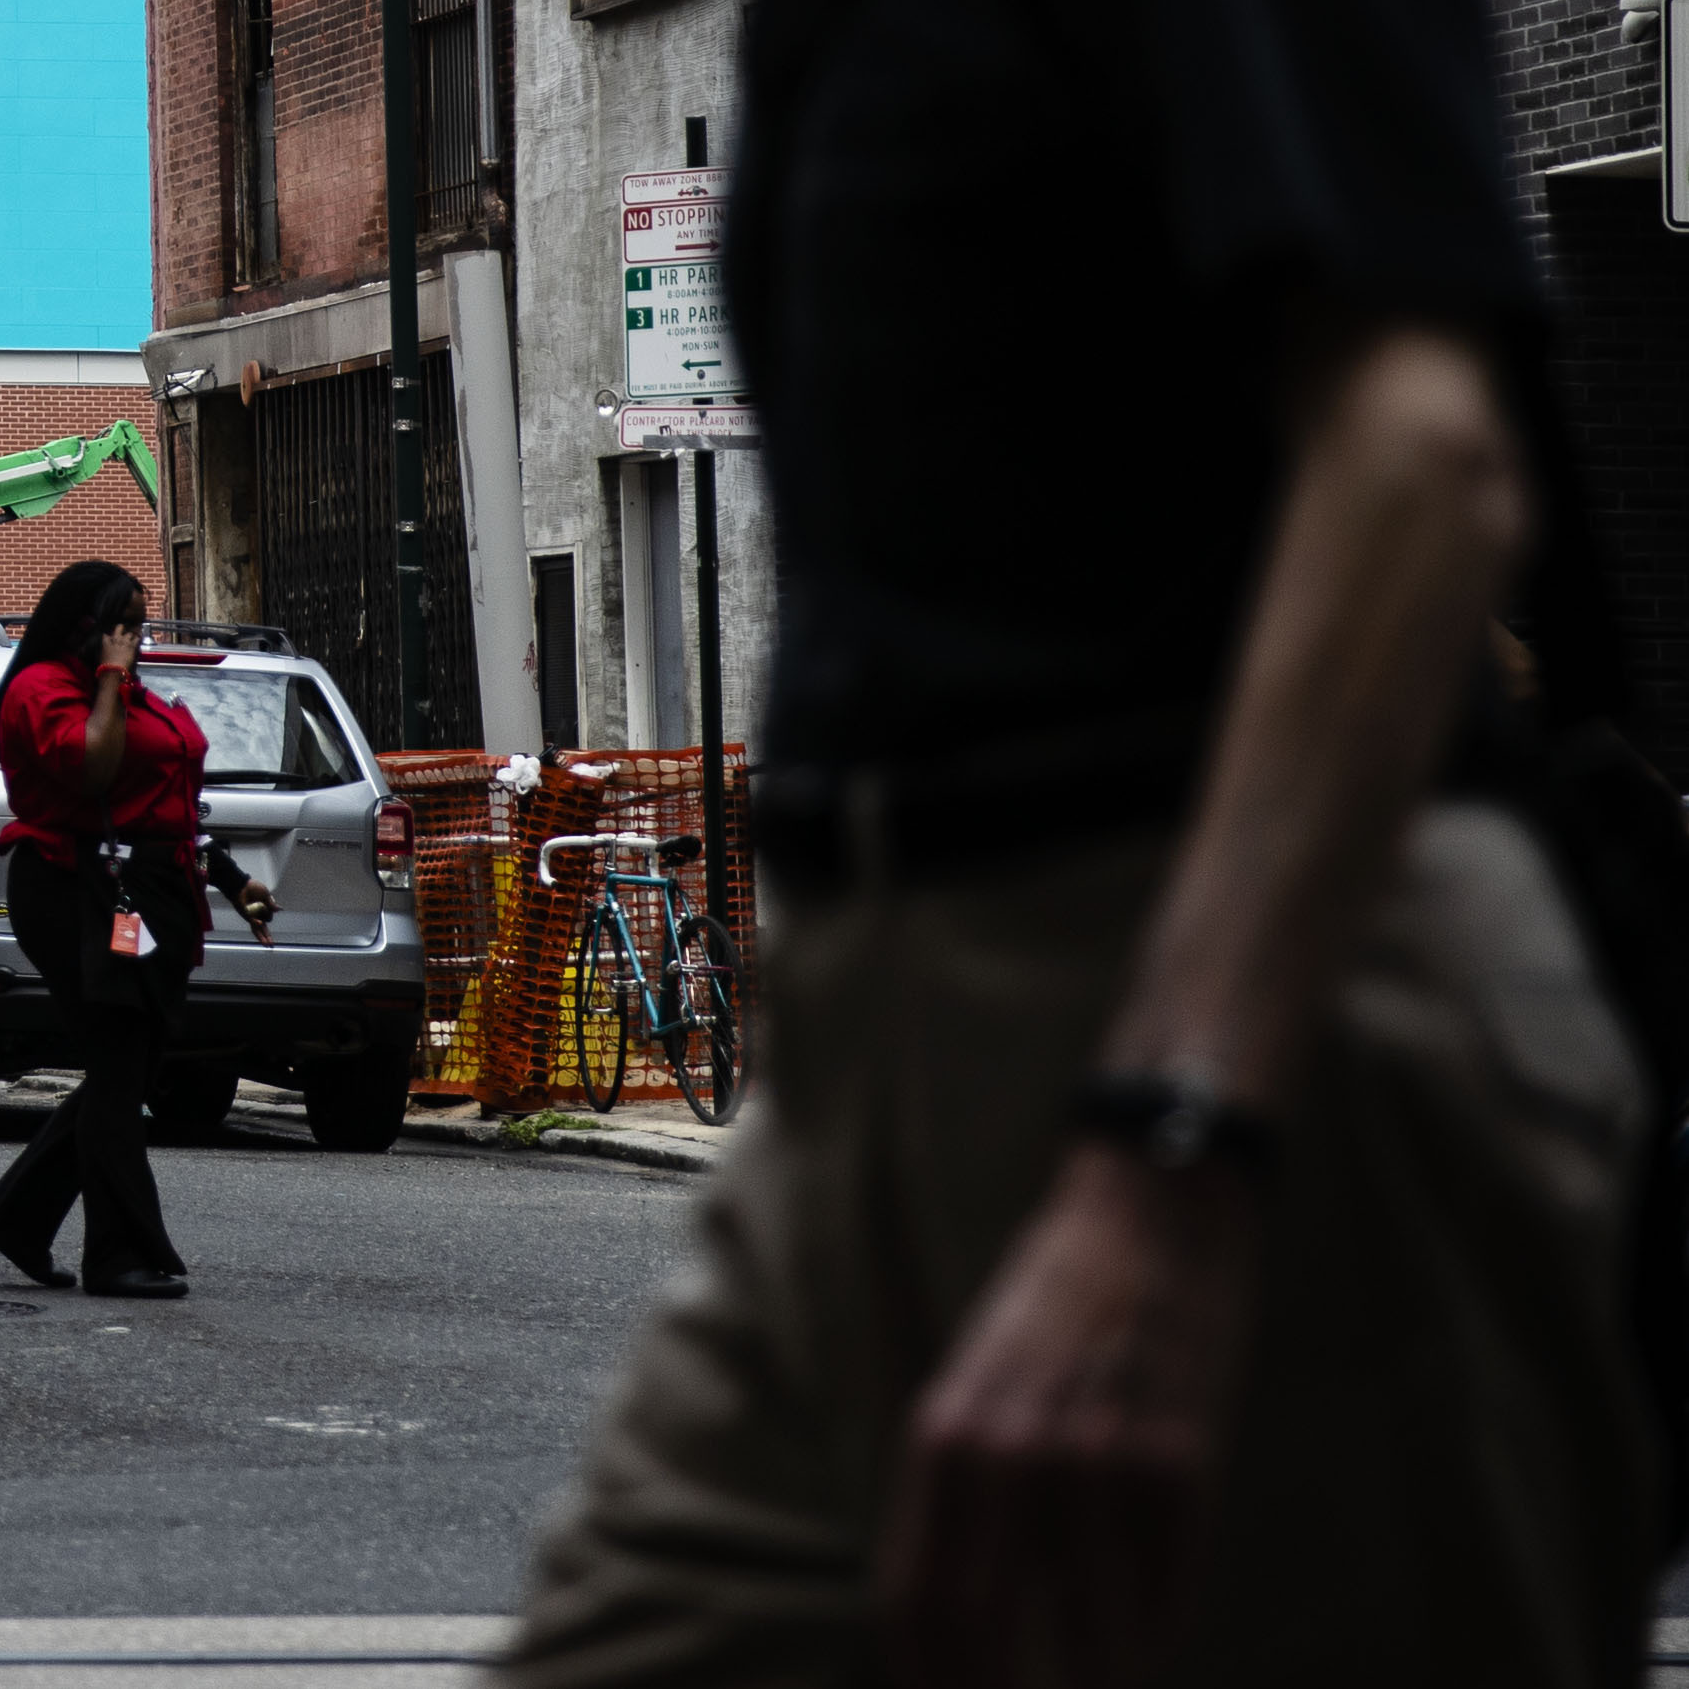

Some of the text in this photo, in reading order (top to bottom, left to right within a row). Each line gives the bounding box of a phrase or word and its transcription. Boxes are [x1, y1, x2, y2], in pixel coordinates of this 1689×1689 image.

[630, 178, 649, 188] TOW
[653, 176, 677, 187] AWAY
[680, 174, 703, 184] ZONE
[627, 207, 726, 229] NO STOPPIN
[677, 228, 720, 239] ANY TIME
[636, 271, 643, 288] 1
[659, 269, 678, 286] HR
[636, 305, 733, 328] 3 HR PARK
[689, 415, 725, 427] PLACARD
[728, 414, 744, 425] NOT
